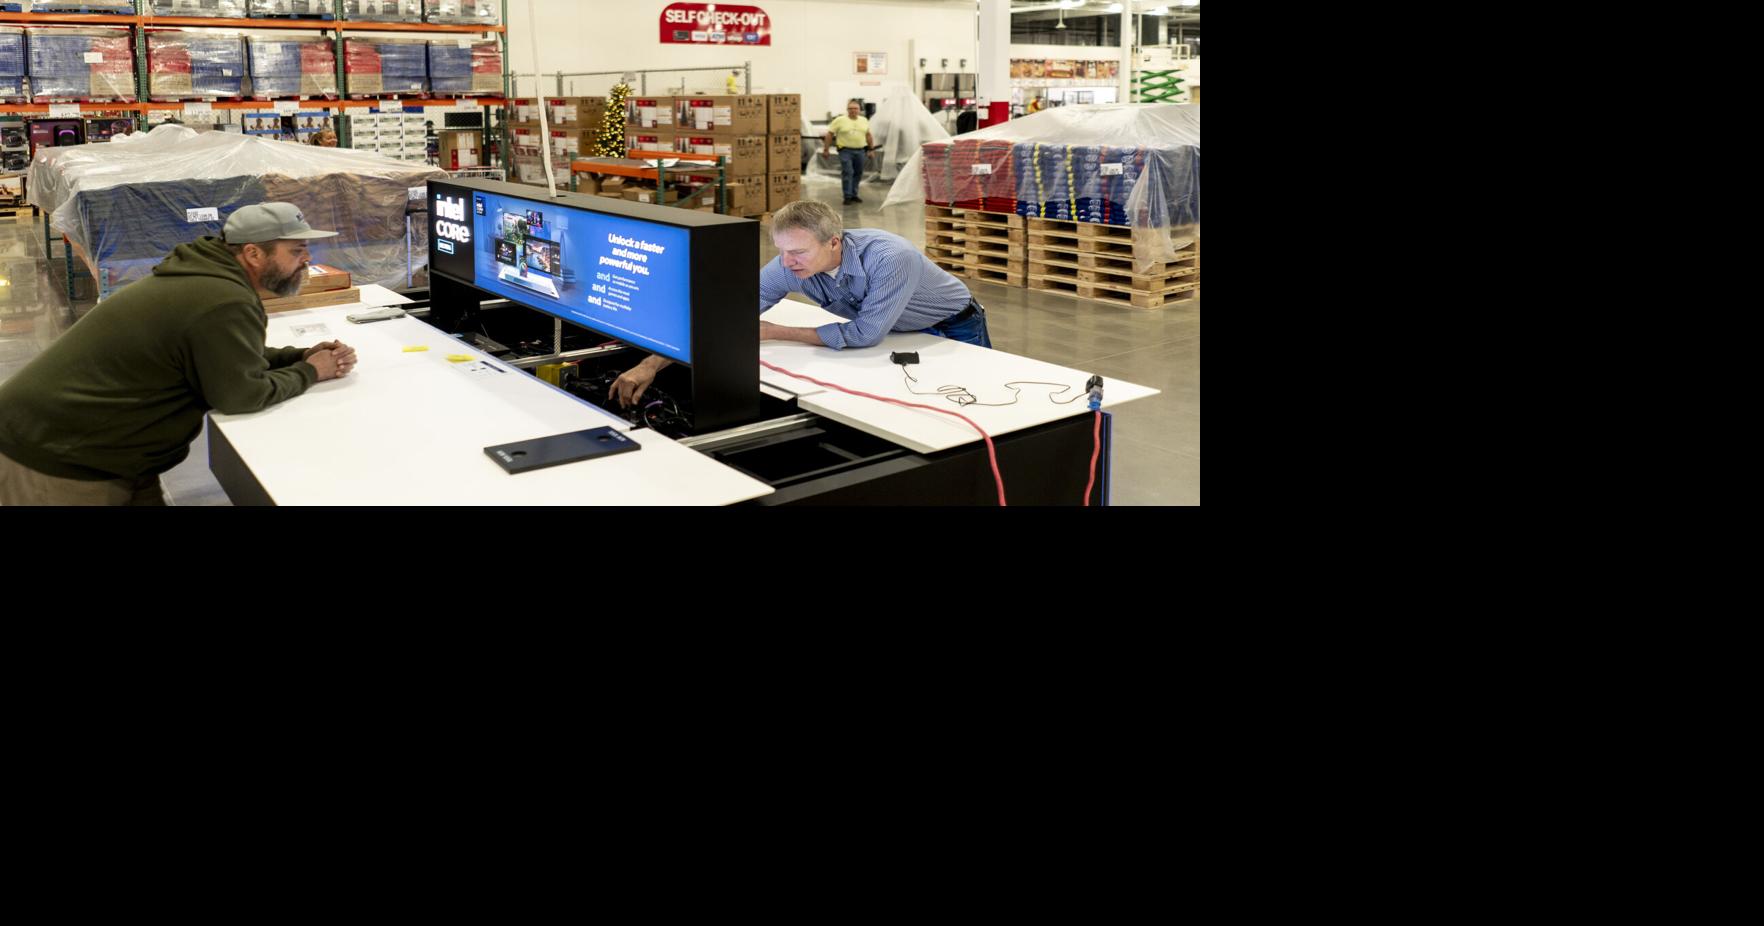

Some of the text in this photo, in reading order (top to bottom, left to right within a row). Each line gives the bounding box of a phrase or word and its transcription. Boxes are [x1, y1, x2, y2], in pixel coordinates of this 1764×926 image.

[665, 9, 766, 26] SELF CHECK-OUT
[436, 194, 464, 221] intel
[608, 233, 634, 248] Unlock
[640, 240, 664, 254] faster
[612, 247, 648, 263] and more
[599, 256, 650, 275] powerful you.
[596, 272, 610, 282] and
[592, 283, 606, 294] and
[587, 295, 602, 306] and
